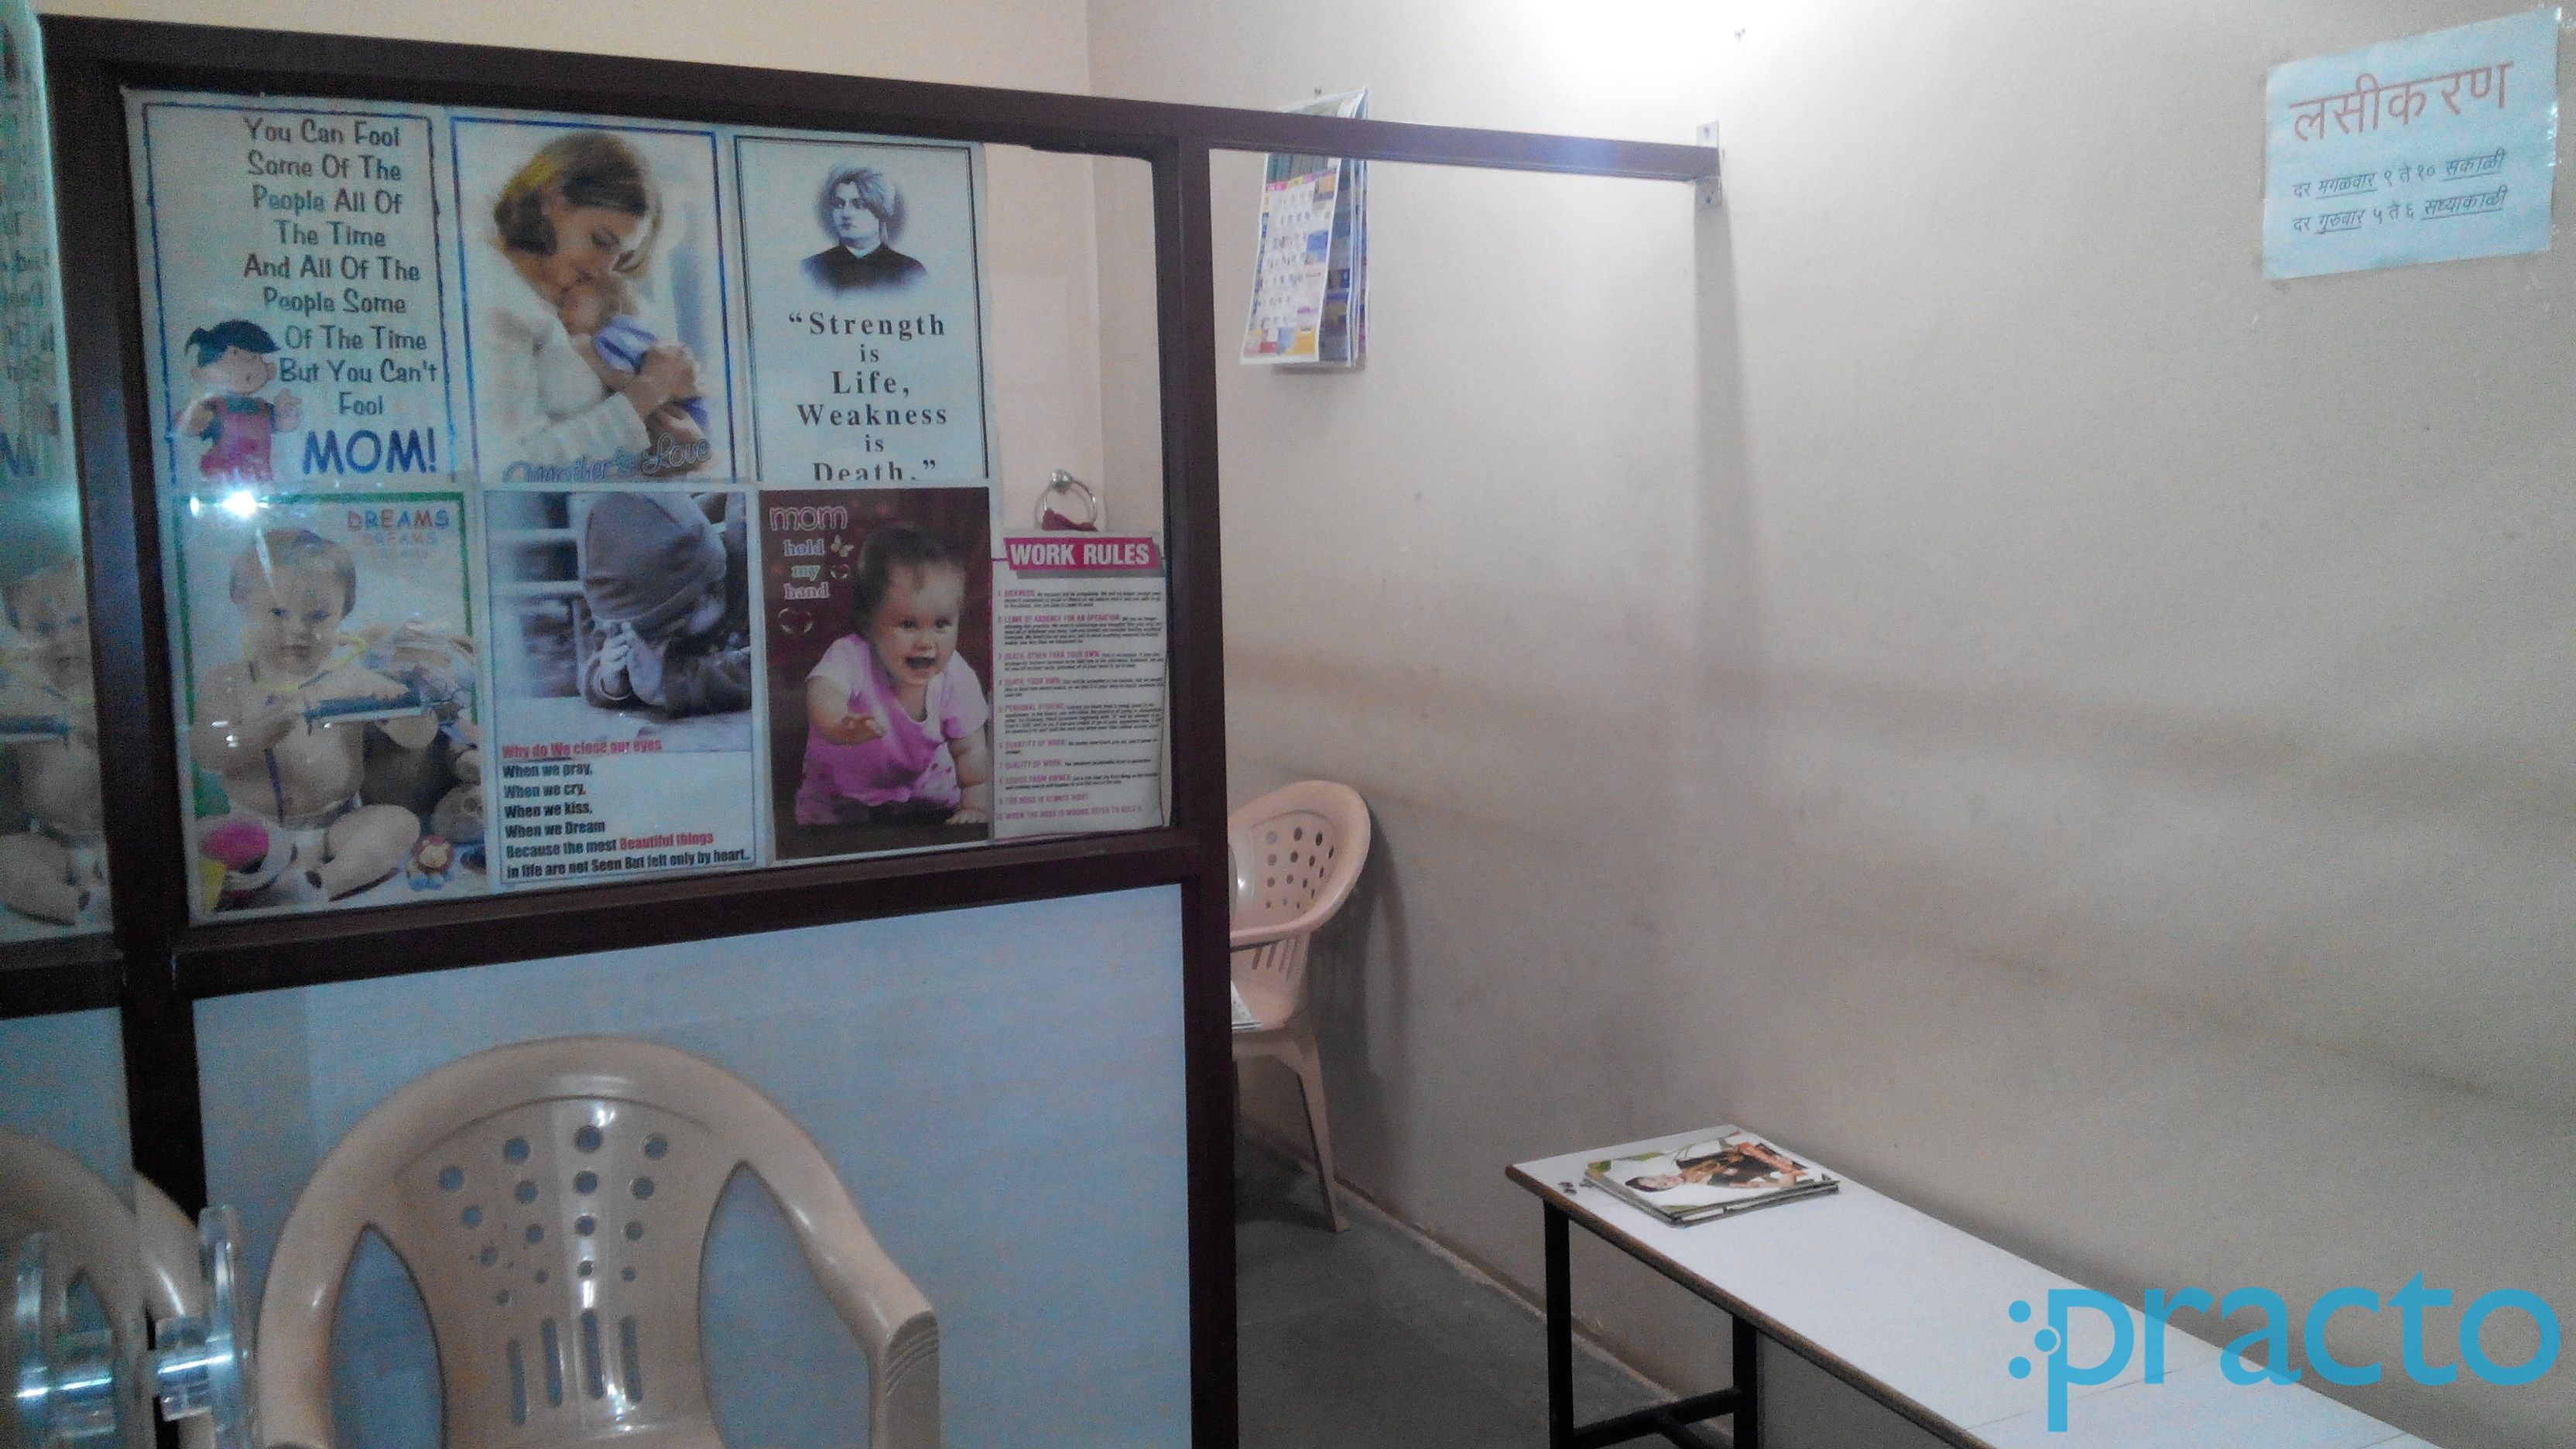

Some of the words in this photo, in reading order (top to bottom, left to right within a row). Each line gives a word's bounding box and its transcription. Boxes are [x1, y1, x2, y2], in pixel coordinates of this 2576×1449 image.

[2289, 60, 2513, 142] लसीकरण
[243, 117, 291, 142] You
[301, 119, 344, 144] Can
[354, 122, 399, 146] Fool
[248, 151, 312, 177] Some
[322, 154, 350, 178] Of
[359, 155, 402, 181] The
[253, 185, 324, 213] People
[334, 187, 366, 213] All
[374, 190, 403, 214] Of
[275, 219, 319, 245] The
[326, 221, 386, 247] Time
[244, 254, 290, 278] And
[300, 255, 331, 278] All
[341, 257, 370, 279] Of
[378, 257, 421, 282] The
[263, 287, 335, 313] People
[343, 289, 406, 314] Some
[285, 326, 314, 350] Of
[320, 325, 363, 350] The
[371, 326, 427, 350] Time
[860, 344, 879, 363] is
[279, 359, 319, 382] But
[327, 360, 372, 384] You
[380, 359, 438, 382] Can't
[831, 371, 909, 398] Life,
[339, 392, 384, 416] Fool
[796, 403, 947, 426] Weakness
[303, 426, 437, 475] MOM!
[641, 433, 712, 475] Love
[865, 433, 884, 453] is
[348, 509, 450, 532] DREAMS
[769, 506, 848, 531] mom
[783, 538, 824, 557] hold
[1009, 543, 1076, 565] WORK
[1084, 543, 1149, 565] RULES
[791, 564, 820, 581] my
[783, 581, 830, 600] hand
[503, 745, 529, 759] Why
[533, 745, 546, 758] do
[551, 743, 570, 756] We
[574, 740, 606, 755] close
[611, 740, 631, 753] our
[633, 739, 662, 752] eyes
[503, 764, 540, 779] When
[542, 765, 560, 776] we
[504, 784, 540, 799] When
[543, 785, 560, 796] we
[505, 805, 541, 819] When
[543, 805, 561, 817] we
[505, 824, 542, 838] When
[544, 825, 562, 837] we
[564, 821, 605, 834] Dream
[506, 843, 560, 858] Because
[563, 841, 583, 855] the
[586, 840, 618, 853] most
[620, 834, 673, 850] Beautiful
[677, 832, 714, 847] things
[521, 863, 543, 878] life
[545, 863, 566, 876] are
[568, 861, 588, 874] not
[591, 858, 621, 873] Seen
[625, 856, 645, 870] But
[646, 855, 667, 868] felt
[670, 852, 695, 867] only
[697, 851, 711, 865] by
